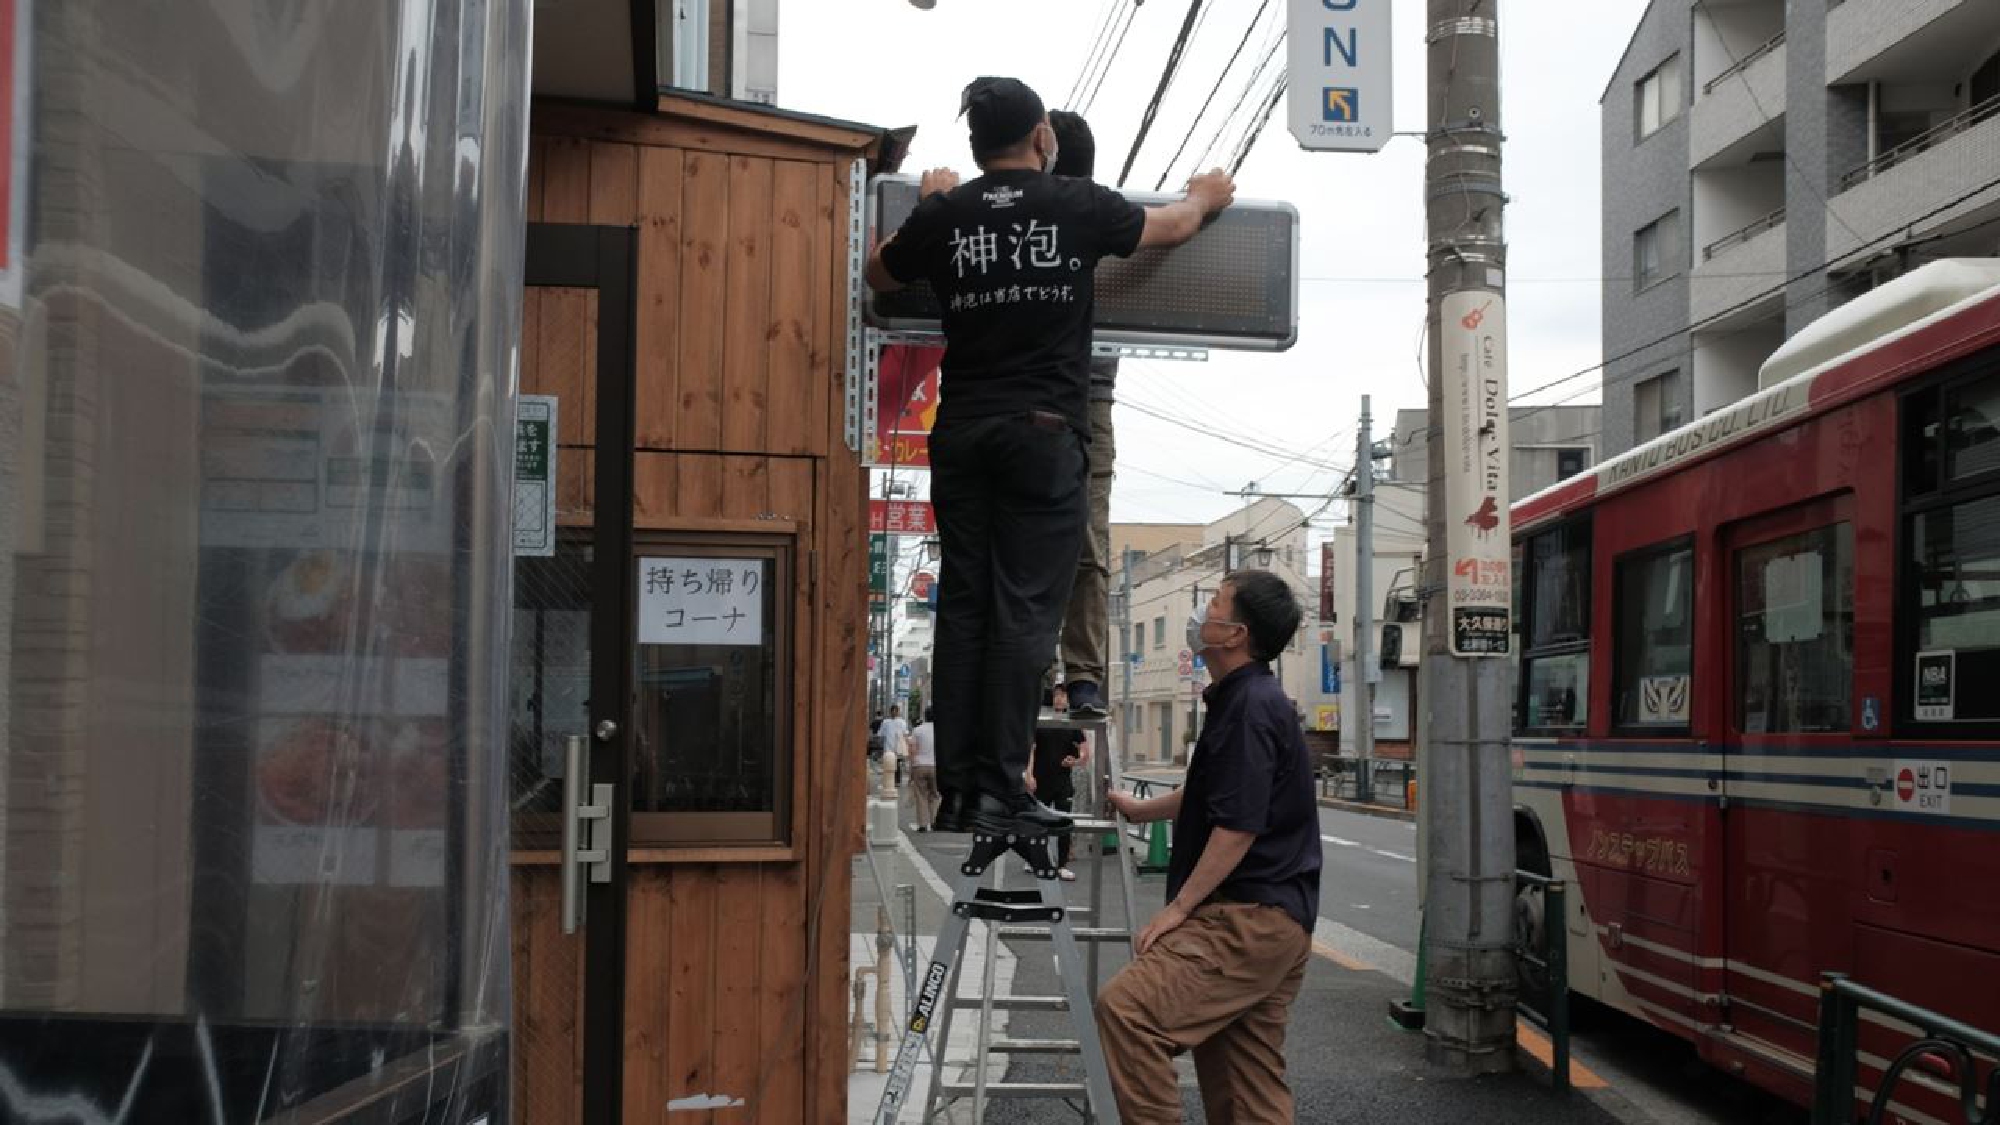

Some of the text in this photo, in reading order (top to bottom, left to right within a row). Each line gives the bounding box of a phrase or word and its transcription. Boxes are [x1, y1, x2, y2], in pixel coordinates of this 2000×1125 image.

[948, 219, 1082, 278] 神泡。
[1665, 429, 1703, 461] BUS
[646, 566, 760, 596] 持ち帰り
[665, 605, 746, 633] コーナ
[1917, 766, 1948, 789] 出口
[1919, 794, 1943, 808] EXIT
[918, 963, 945, 1017] ALINCO
